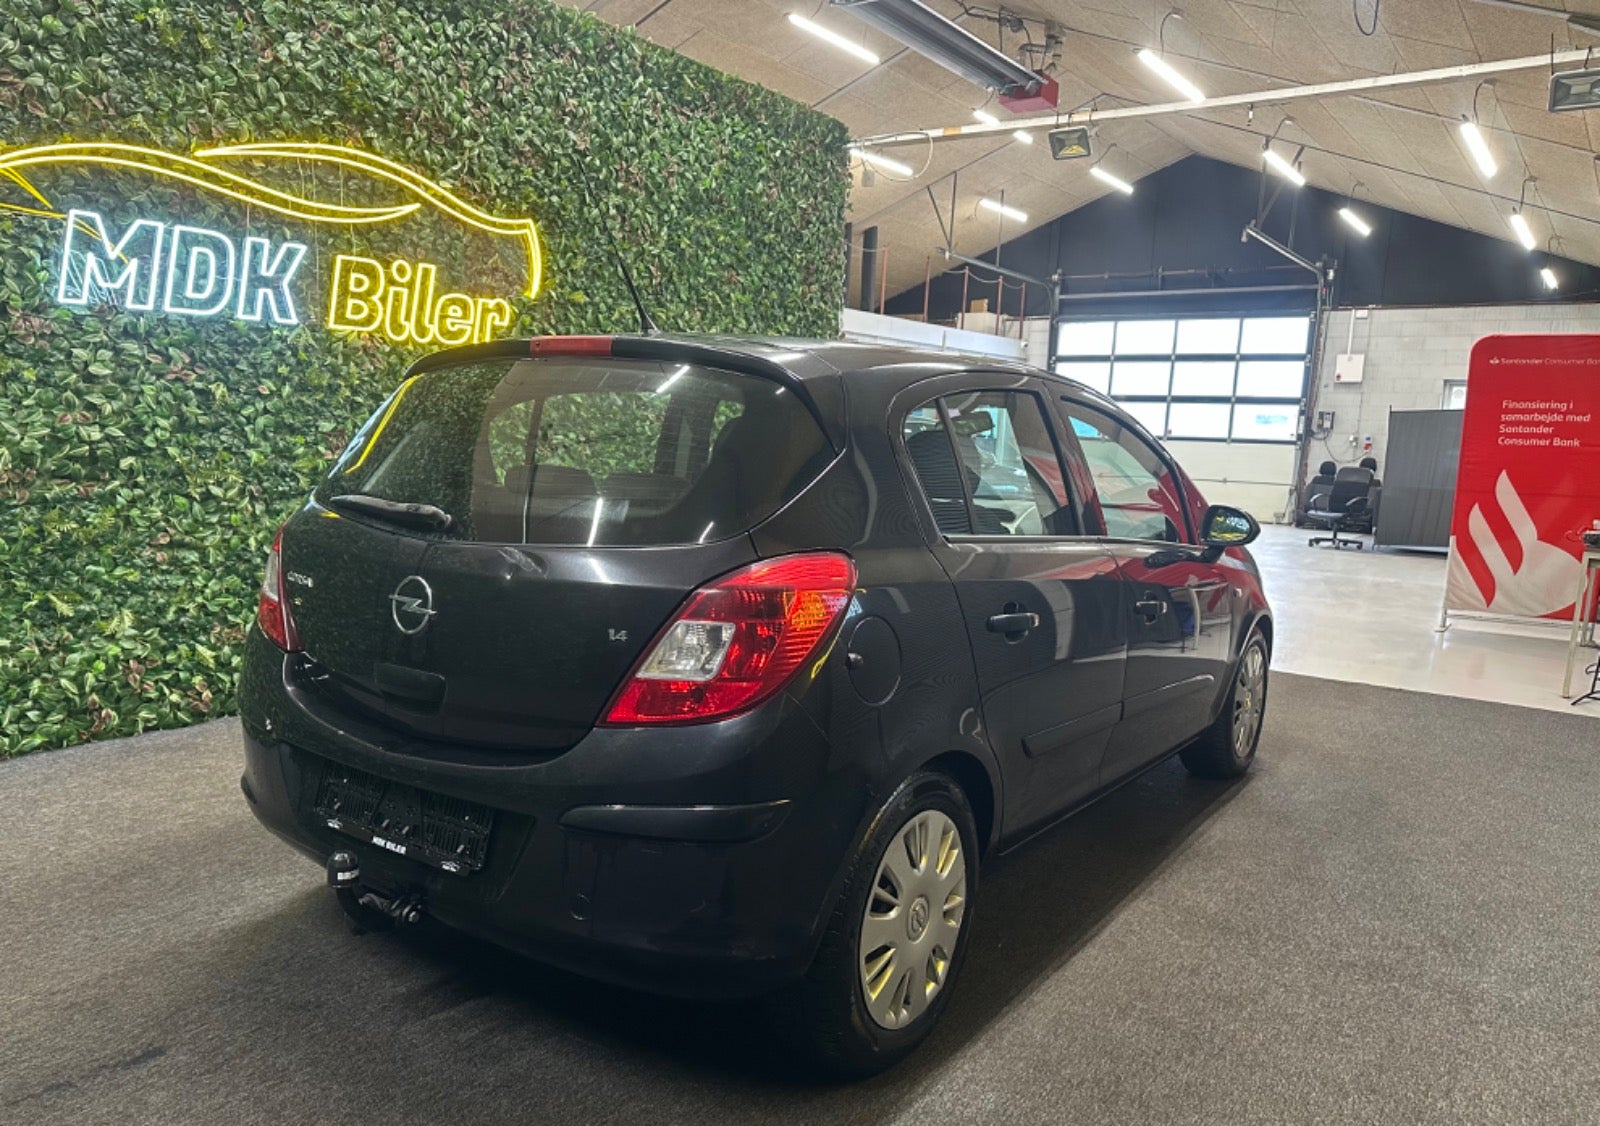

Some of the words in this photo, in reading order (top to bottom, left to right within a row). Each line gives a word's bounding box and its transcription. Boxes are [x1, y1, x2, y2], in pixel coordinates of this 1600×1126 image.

[57, 209, 307, 325] MDK
[328, 254, 510, 345] Biler
[1501, 357, 1543, 365] Santander
[1544, 358, 1585, 366] Consumer
[1502, 400, 1567, 411] Finansiering
[1501, 412, 1564, 423] samarbejde
[1565, 414, 1591, 422] med
[1499, 424, 1554, 433] Santander
[1498, 436, 1550, 446] Consumer
[1552, 437, 1580, 447] Bank
